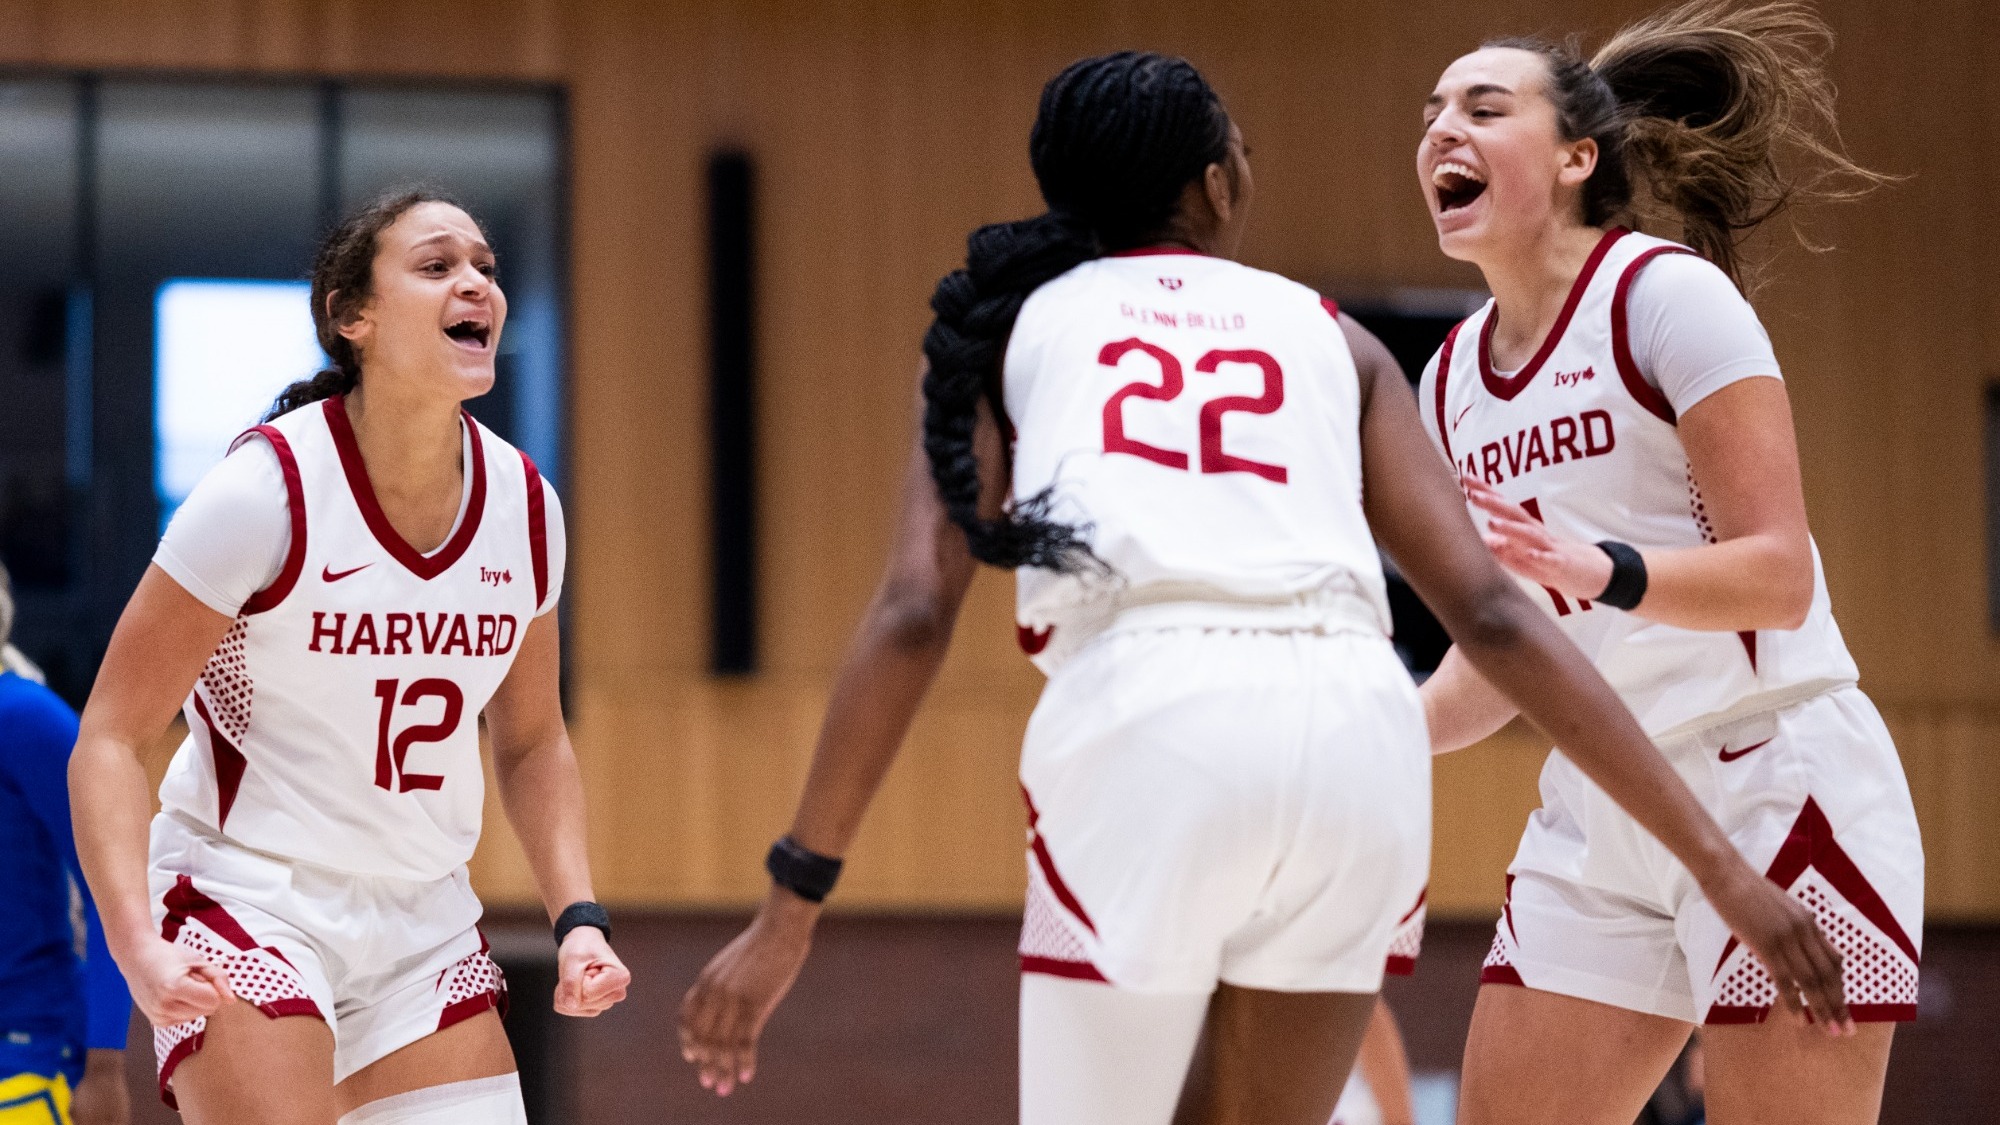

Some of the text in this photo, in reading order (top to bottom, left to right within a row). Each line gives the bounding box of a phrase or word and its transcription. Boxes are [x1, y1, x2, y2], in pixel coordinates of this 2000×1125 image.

[1554, 370, 1582, 388] Ivy
[1098, 337, 1287, 484] 22
[480, 566, 501, 587] Ivy
[308, 611, 517, 656] HARVARD
[374, 678, 464, 793] 12
